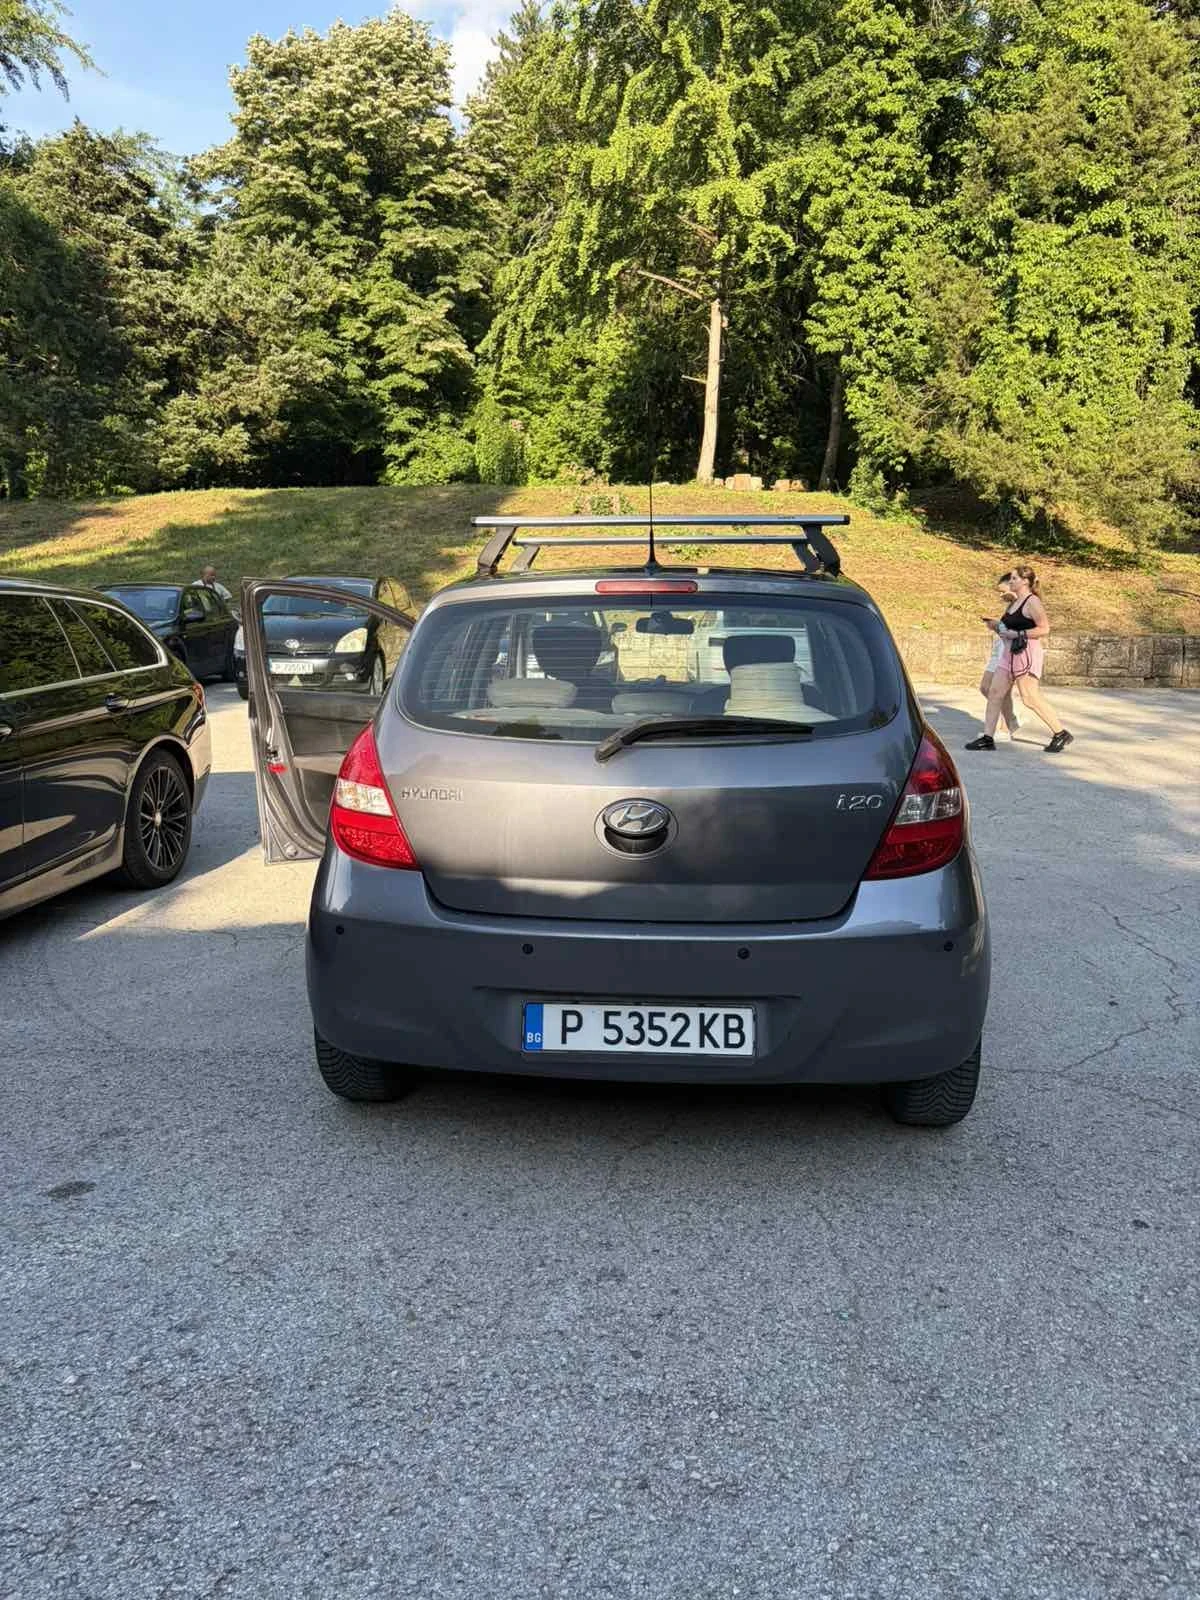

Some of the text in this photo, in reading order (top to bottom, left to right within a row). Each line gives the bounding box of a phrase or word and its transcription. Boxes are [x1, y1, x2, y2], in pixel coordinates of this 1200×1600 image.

[401, 786, 464, 801] HYUNDAI
[836, 794, 883, 810] i20
[560, 1009, 583, 1045] P
[526, 1032, 541, 1043] BG
